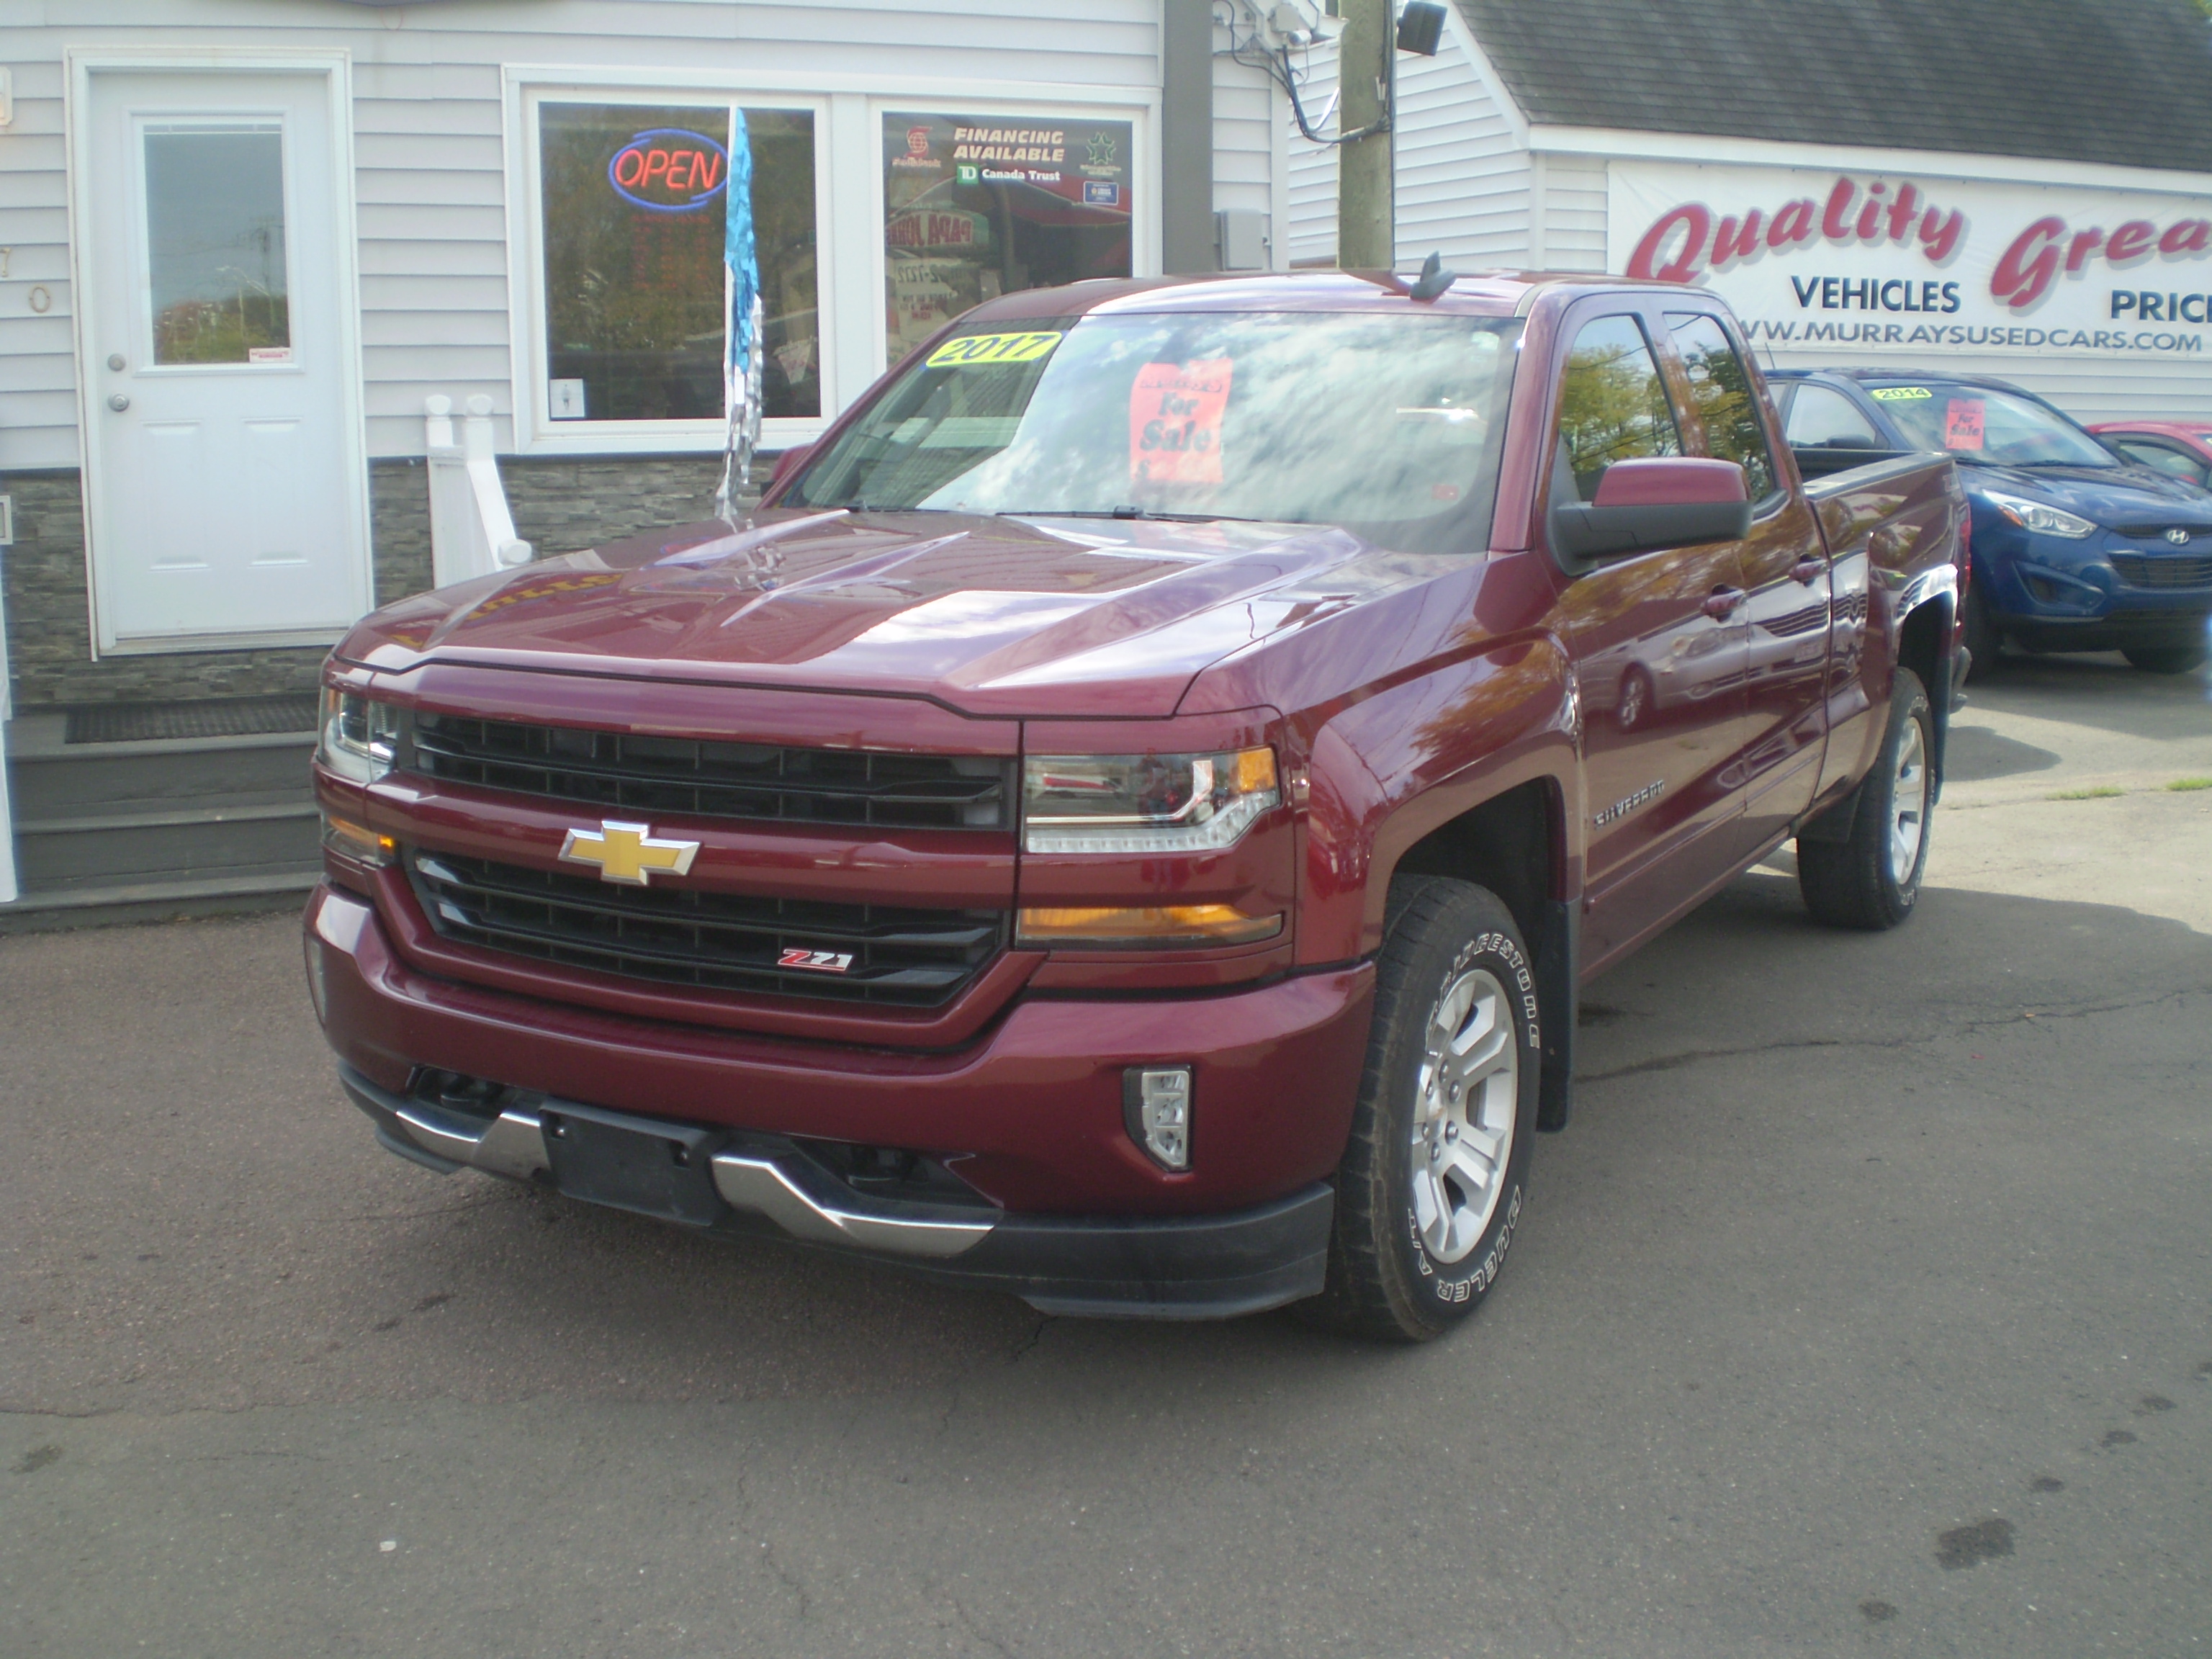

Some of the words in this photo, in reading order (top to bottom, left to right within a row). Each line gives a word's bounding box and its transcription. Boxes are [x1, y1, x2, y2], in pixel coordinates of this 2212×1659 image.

[954, 127, 1064, 143] FINANCING
[953, 145, 1064, 161] AVAILABLE
[614, 148, 720, 189] OPEN
[959, 166, 977, 180] TD
[982, 168, 1025, 179] Canada
[1028, 170, 1061, 181] Trust
[1625, 175, 1967, 284] Quality
[1990, 215, 2212, 308] Grea
[1791, 276, 1961, 313] VEHICLES
[930, 335, 1057, 364] 2017
[1158, 392, 1200, 416] For
[1879, 389, 1928, 399] 2014
[1139, 419, 1212, 452] Sale
[778, 948, 853, 971] Z71
[1437, 1184, 1522, 1303] DUELER
